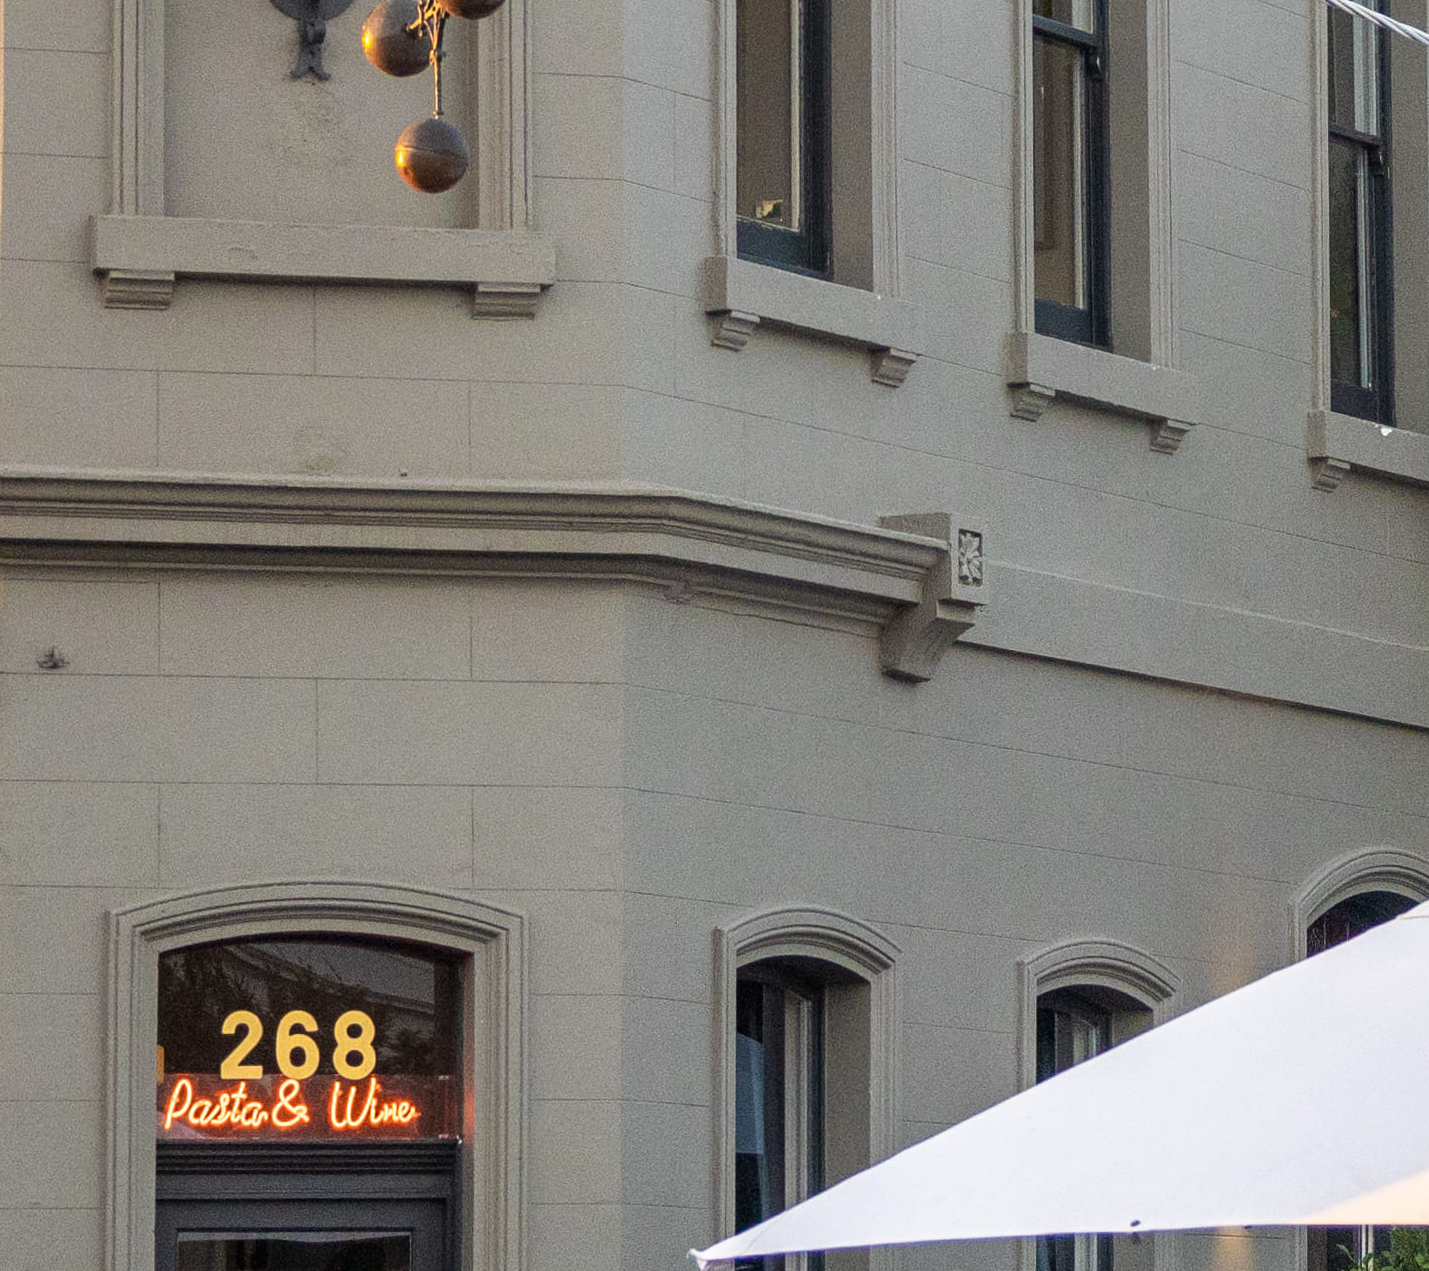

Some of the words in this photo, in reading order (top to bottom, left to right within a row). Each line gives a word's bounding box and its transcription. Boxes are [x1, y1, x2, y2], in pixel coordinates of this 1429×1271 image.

[220, 1010, 377, 1080] 268
[164, 1078, 269, 1130] Pasta
[271, 1079, 310, 1128] &
[329, 1076, 419, 1129] Wine
